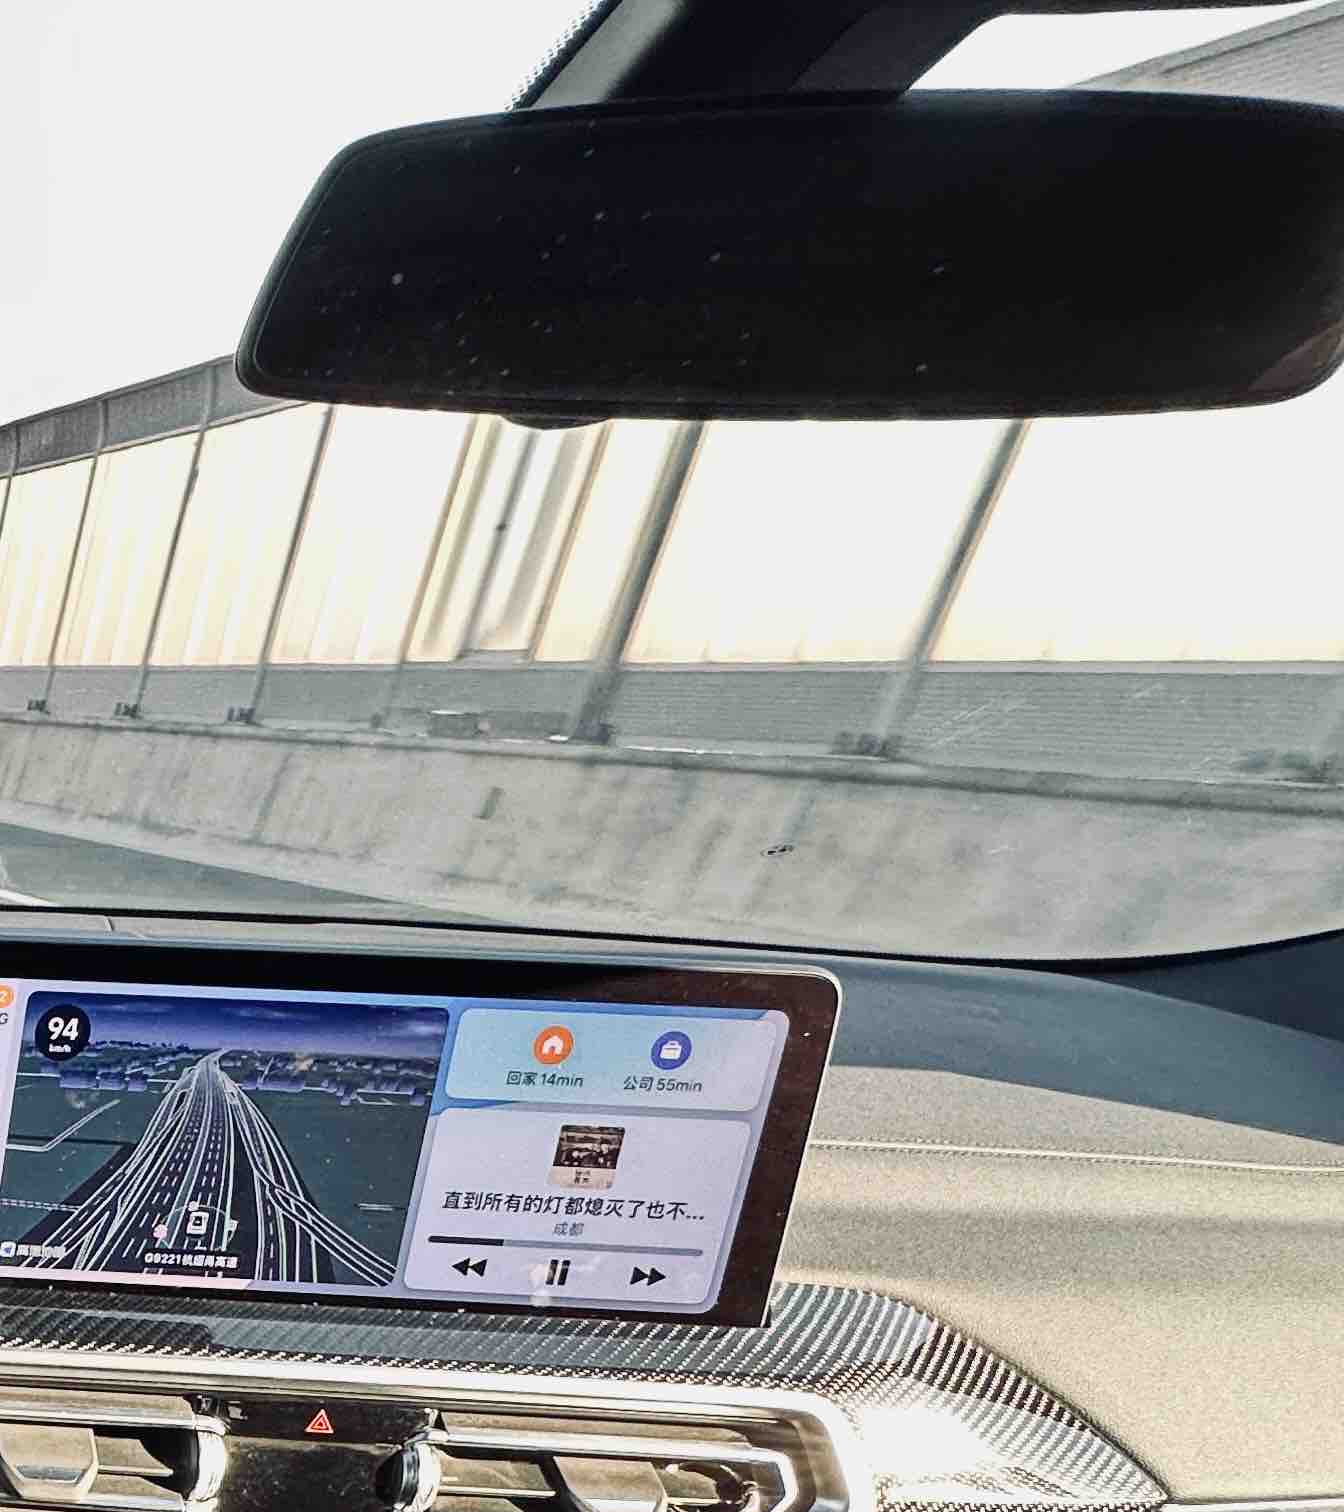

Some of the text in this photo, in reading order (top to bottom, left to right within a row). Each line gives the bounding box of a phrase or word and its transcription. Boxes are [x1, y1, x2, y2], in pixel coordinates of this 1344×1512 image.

[48, 1016, 79, 1041] 94
[505, 1070, 584, 1088] 回家 14min
[623, 1075, 703, 1093] 公司 55min
[552, 1222, 584, 1236] 成都
